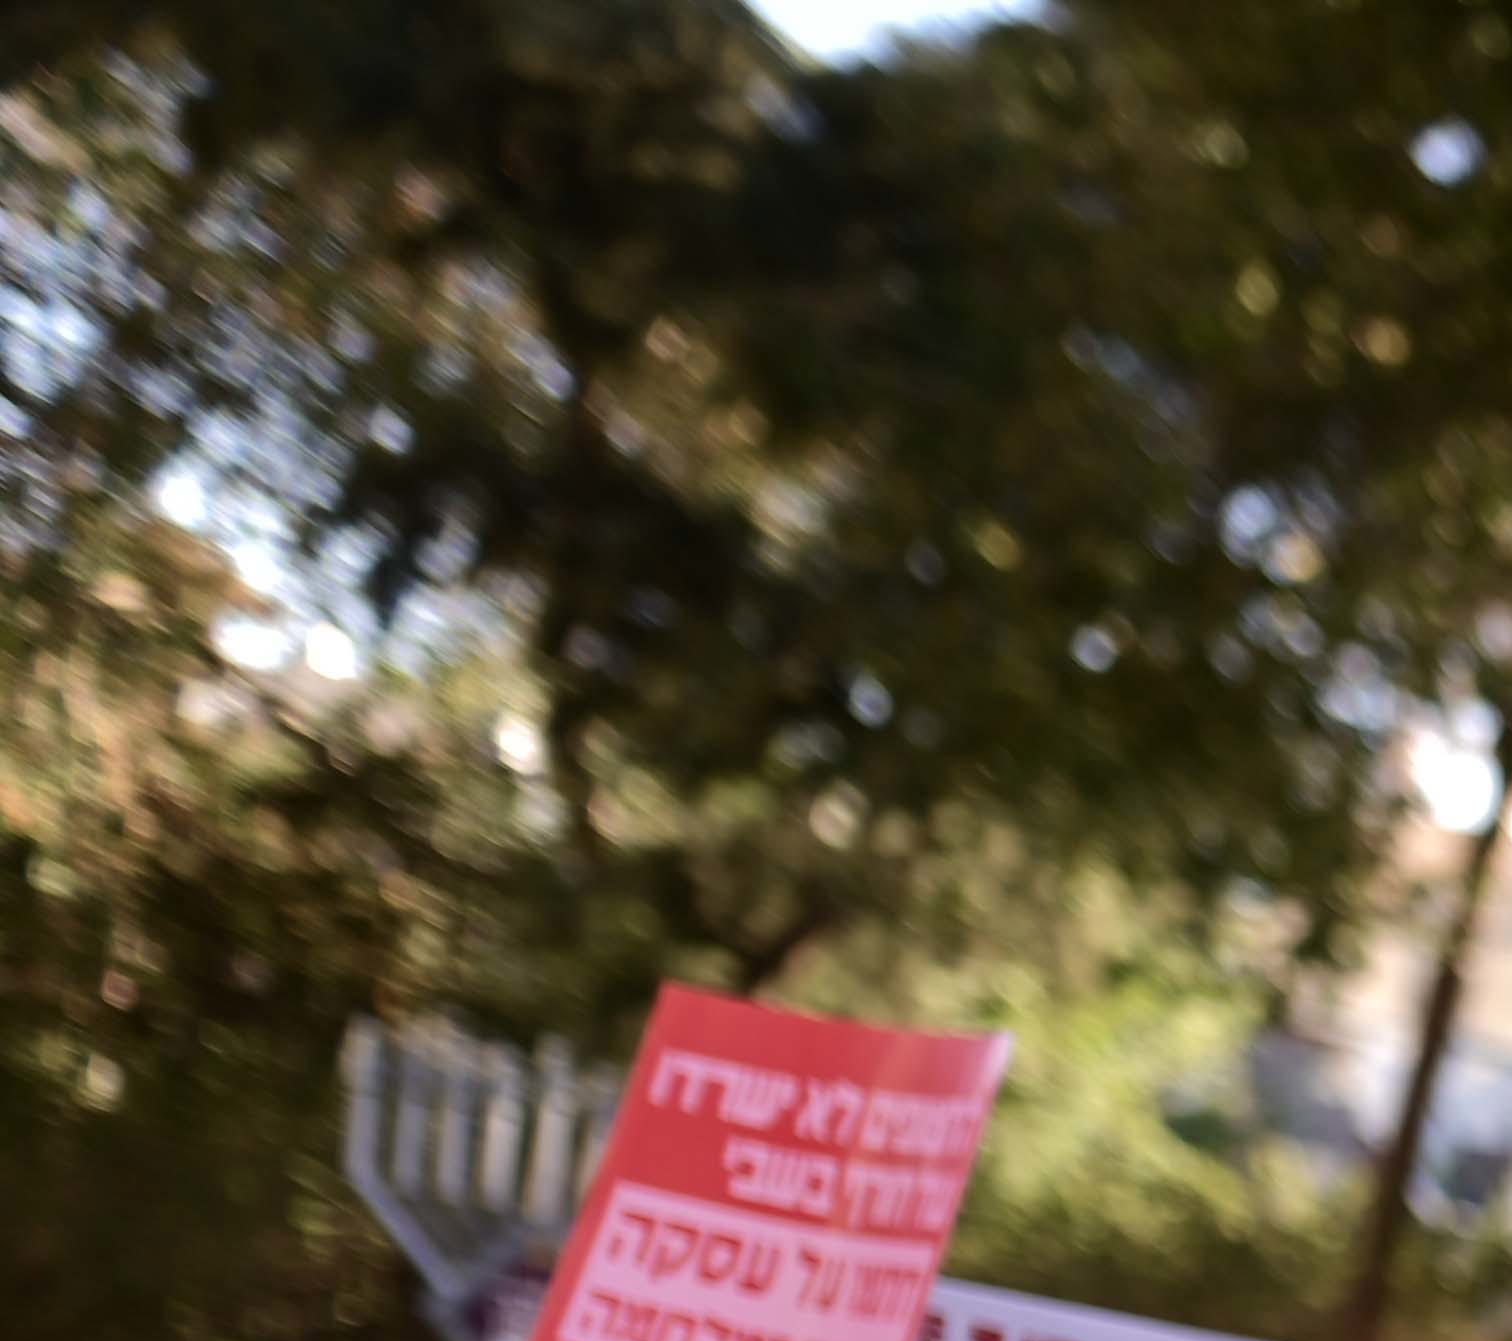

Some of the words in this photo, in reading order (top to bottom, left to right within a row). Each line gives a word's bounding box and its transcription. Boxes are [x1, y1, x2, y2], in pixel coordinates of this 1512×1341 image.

[649, 1047, 797, 1130] ישרדו
[795, 1077, 864, 1145] לא
[722, 1135, 837, 1215] בשבי
[607, 1211, 778, 1293] עסקה
[798, 1247, 844, 1306] על
